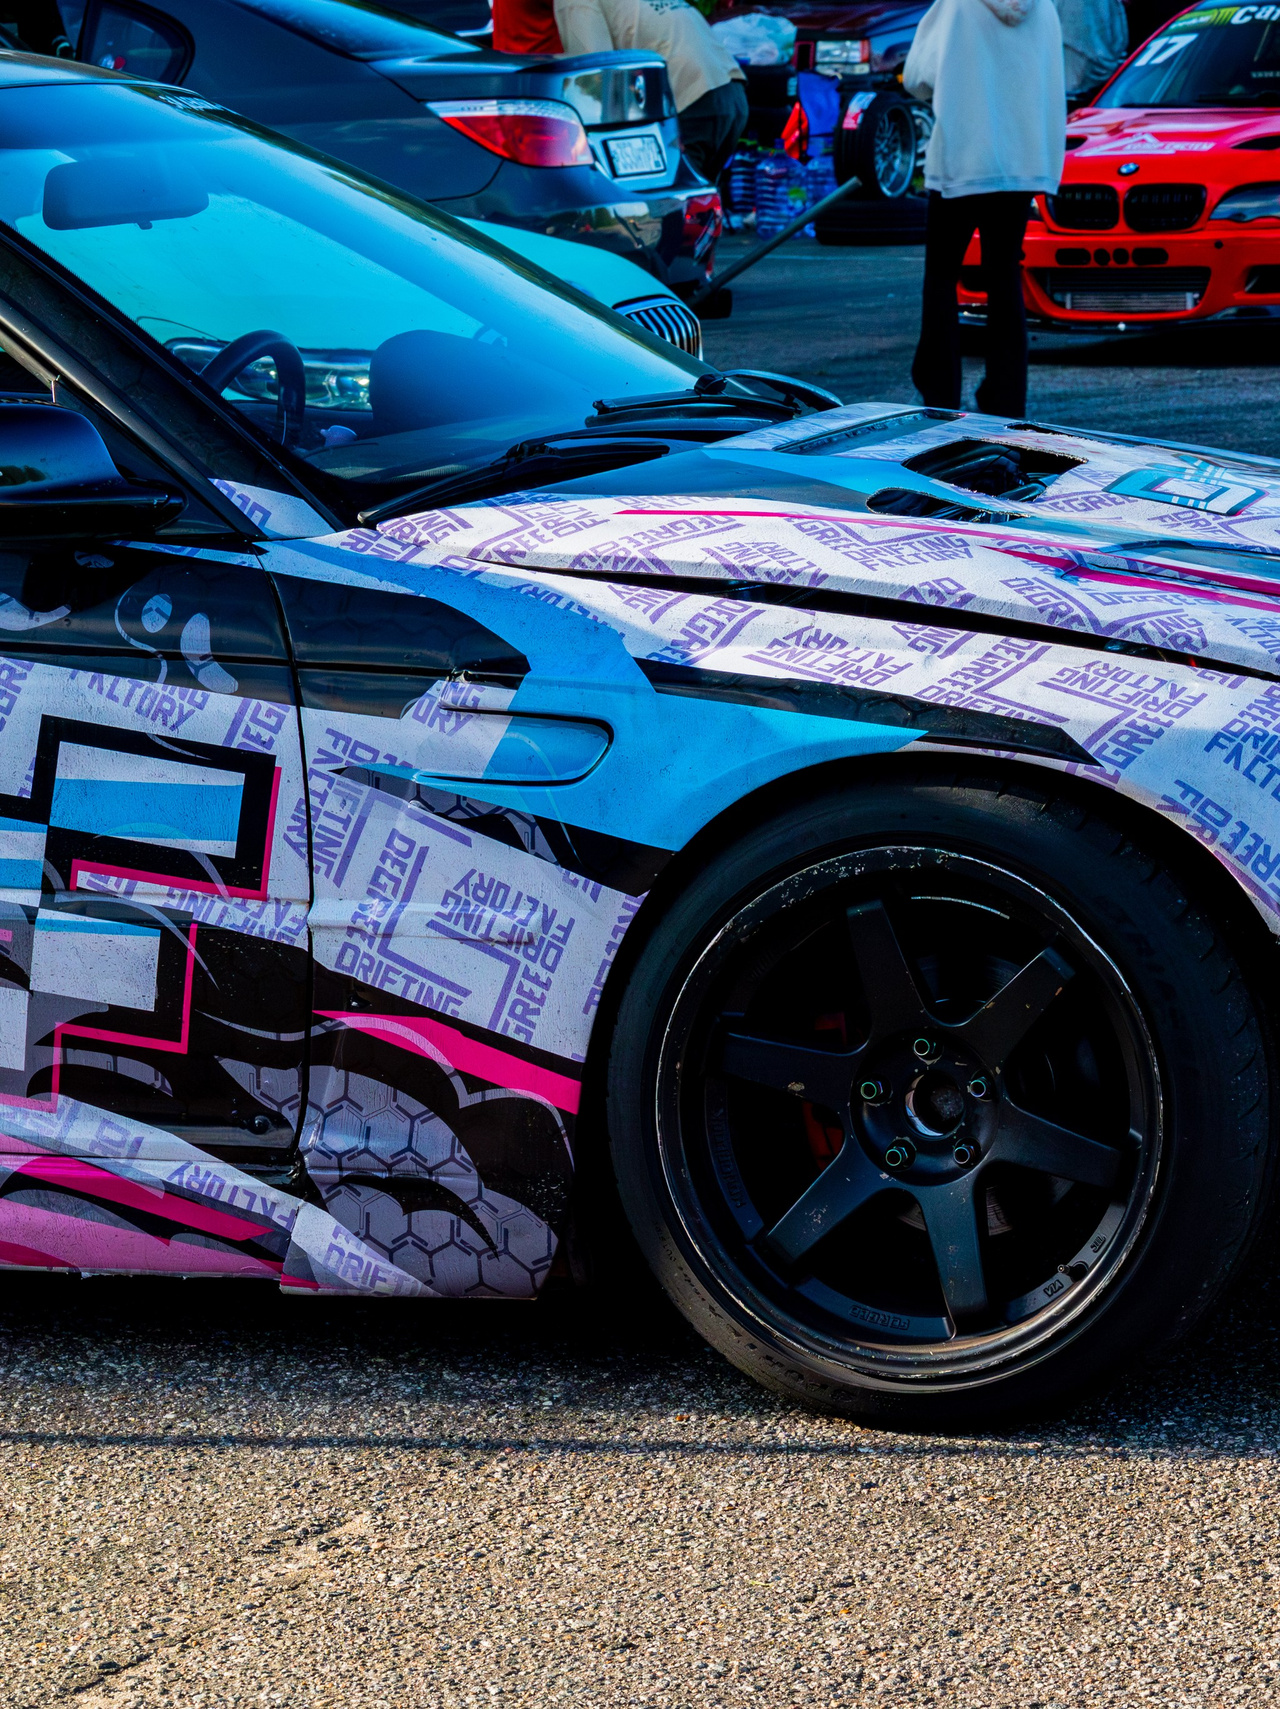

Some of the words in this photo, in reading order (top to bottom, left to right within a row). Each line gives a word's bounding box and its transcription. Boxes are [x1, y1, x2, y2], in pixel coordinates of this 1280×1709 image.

[1135, 33, 1198, 67] 17
[745, 541, 829, 588] ACTORY
[757, 637, 893, 687] DRIFTING
[782, 625, 914, 675] FACTORY
[1048, 666, 1193, 719] DRIFTING
[1074, 659, 1209, 707] FACTORY
[346, 827, 417, 951] DEGREE
[453, 867, 576, 946] FACTORY
[433, 888, 565, 975] DRIFTING
